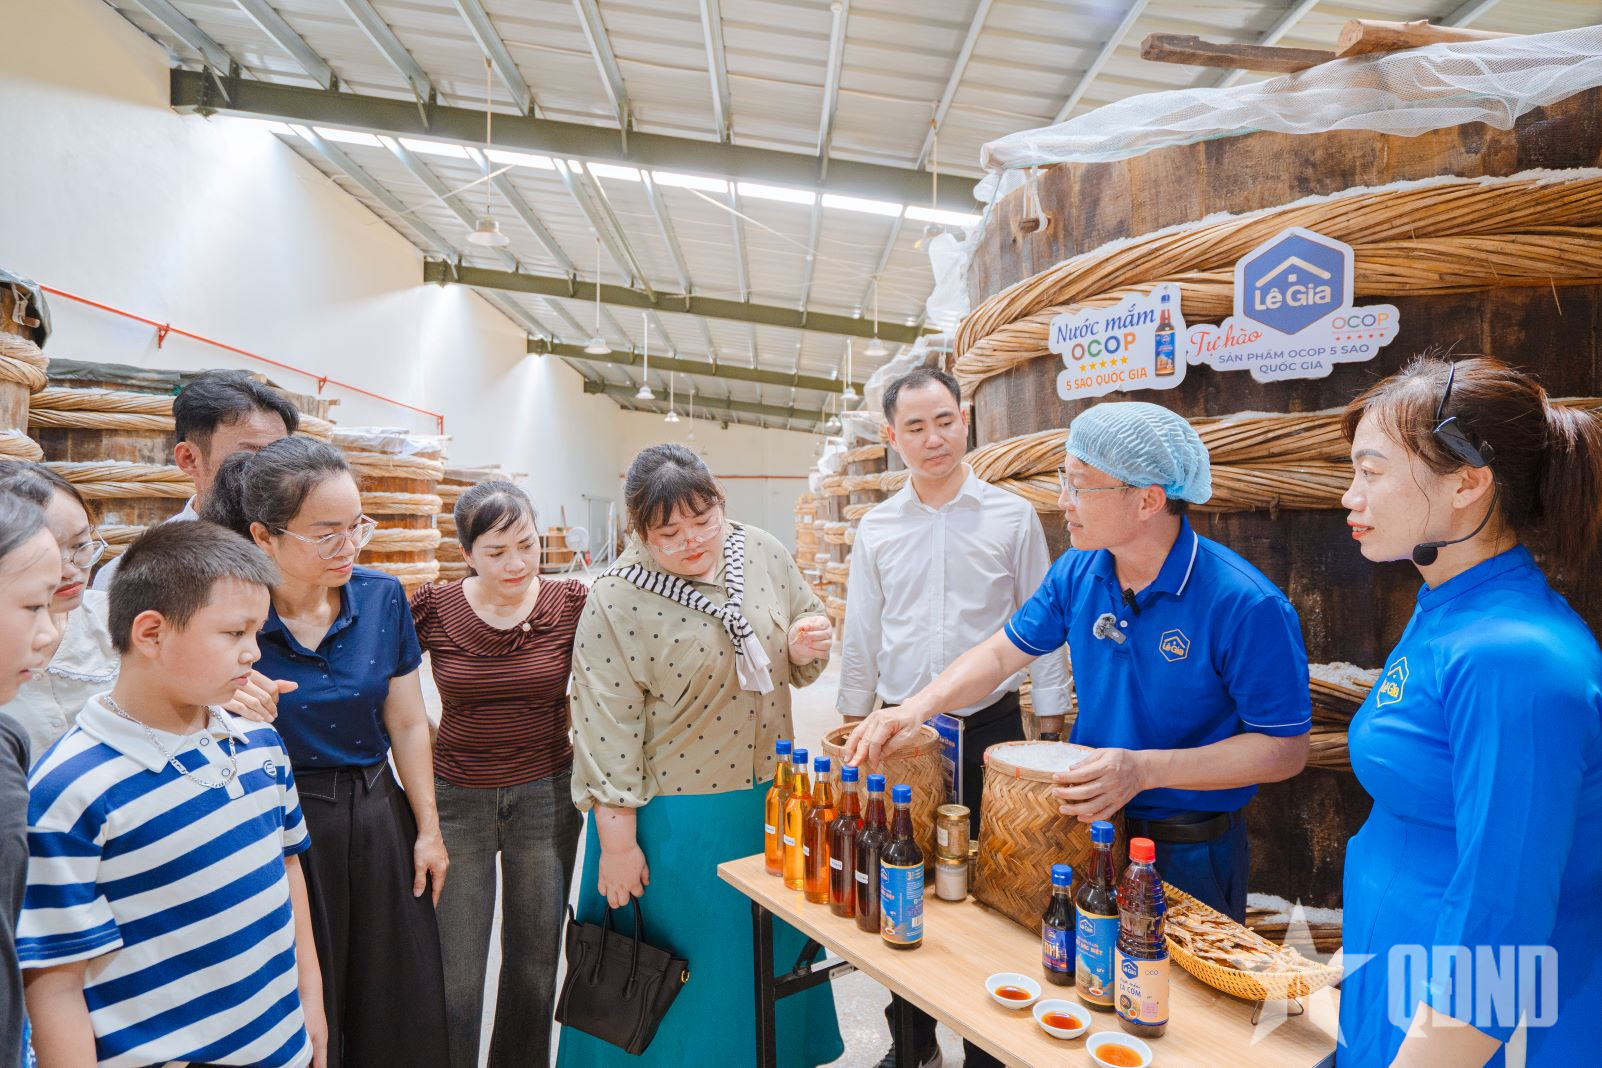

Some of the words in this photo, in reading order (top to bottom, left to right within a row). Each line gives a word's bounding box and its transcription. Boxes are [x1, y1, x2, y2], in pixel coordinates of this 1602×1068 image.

[1254, 287, 1283, 311] Lê
[1285, 283, 1332, 307] Gia
[1056, 318, 1099, 344] Nước
[1104, 303, 1156, 333] mắm
[1331, 312, 1389, 330] OCOP
[1071, 332, 1137, 361] OCOP
[1222, 323, 1263, 348] hào
[1288, 347, 1326, 359] OCOP
[1329, 347, 1337, 355] 5
[1341, 343, 1370, 354] SAO
[1065, 380, 1073, 391] 5
[1074, 376, 1093, 390] SAO
[1128, 367, 1148, 381] GIA
[1259, 360, 1297, 374] QUỐC
[1300, 360, 1324, 370] GIA
